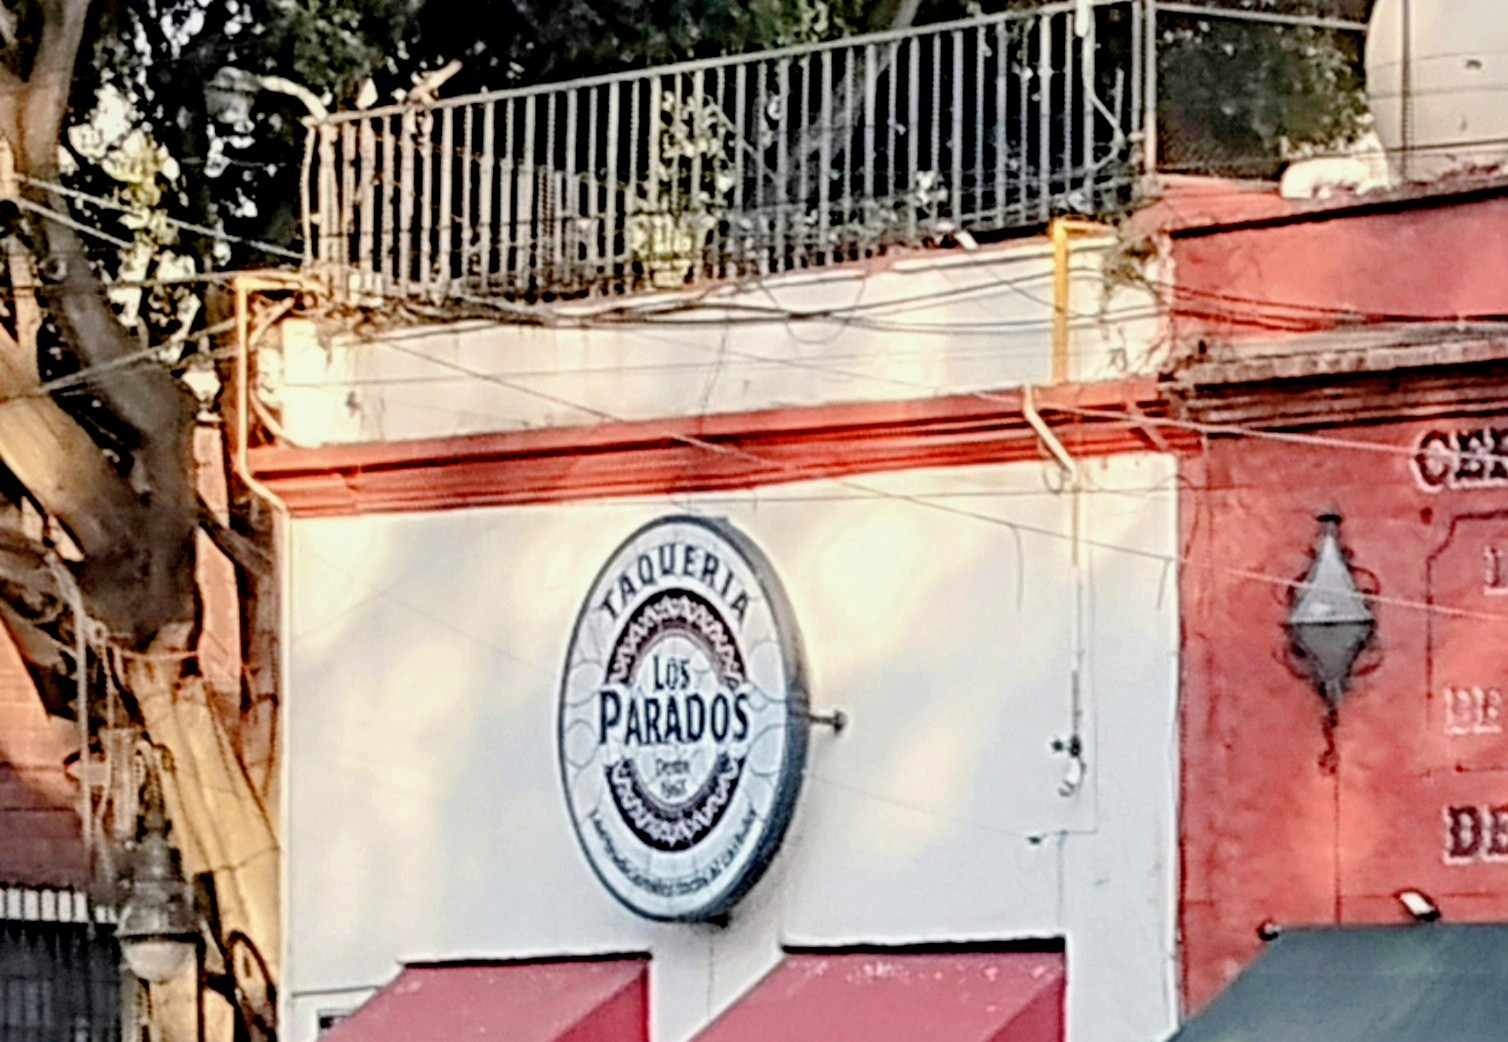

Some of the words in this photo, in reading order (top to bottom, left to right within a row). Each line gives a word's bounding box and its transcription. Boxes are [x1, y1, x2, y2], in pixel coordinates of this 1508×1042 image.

[598, 543, 749, 623] TAQUERIA
[652, 654, 691, 691] LOS
[599, 690, 749, 746] PARADOS
[1444, 686, 1501, 735] DE
